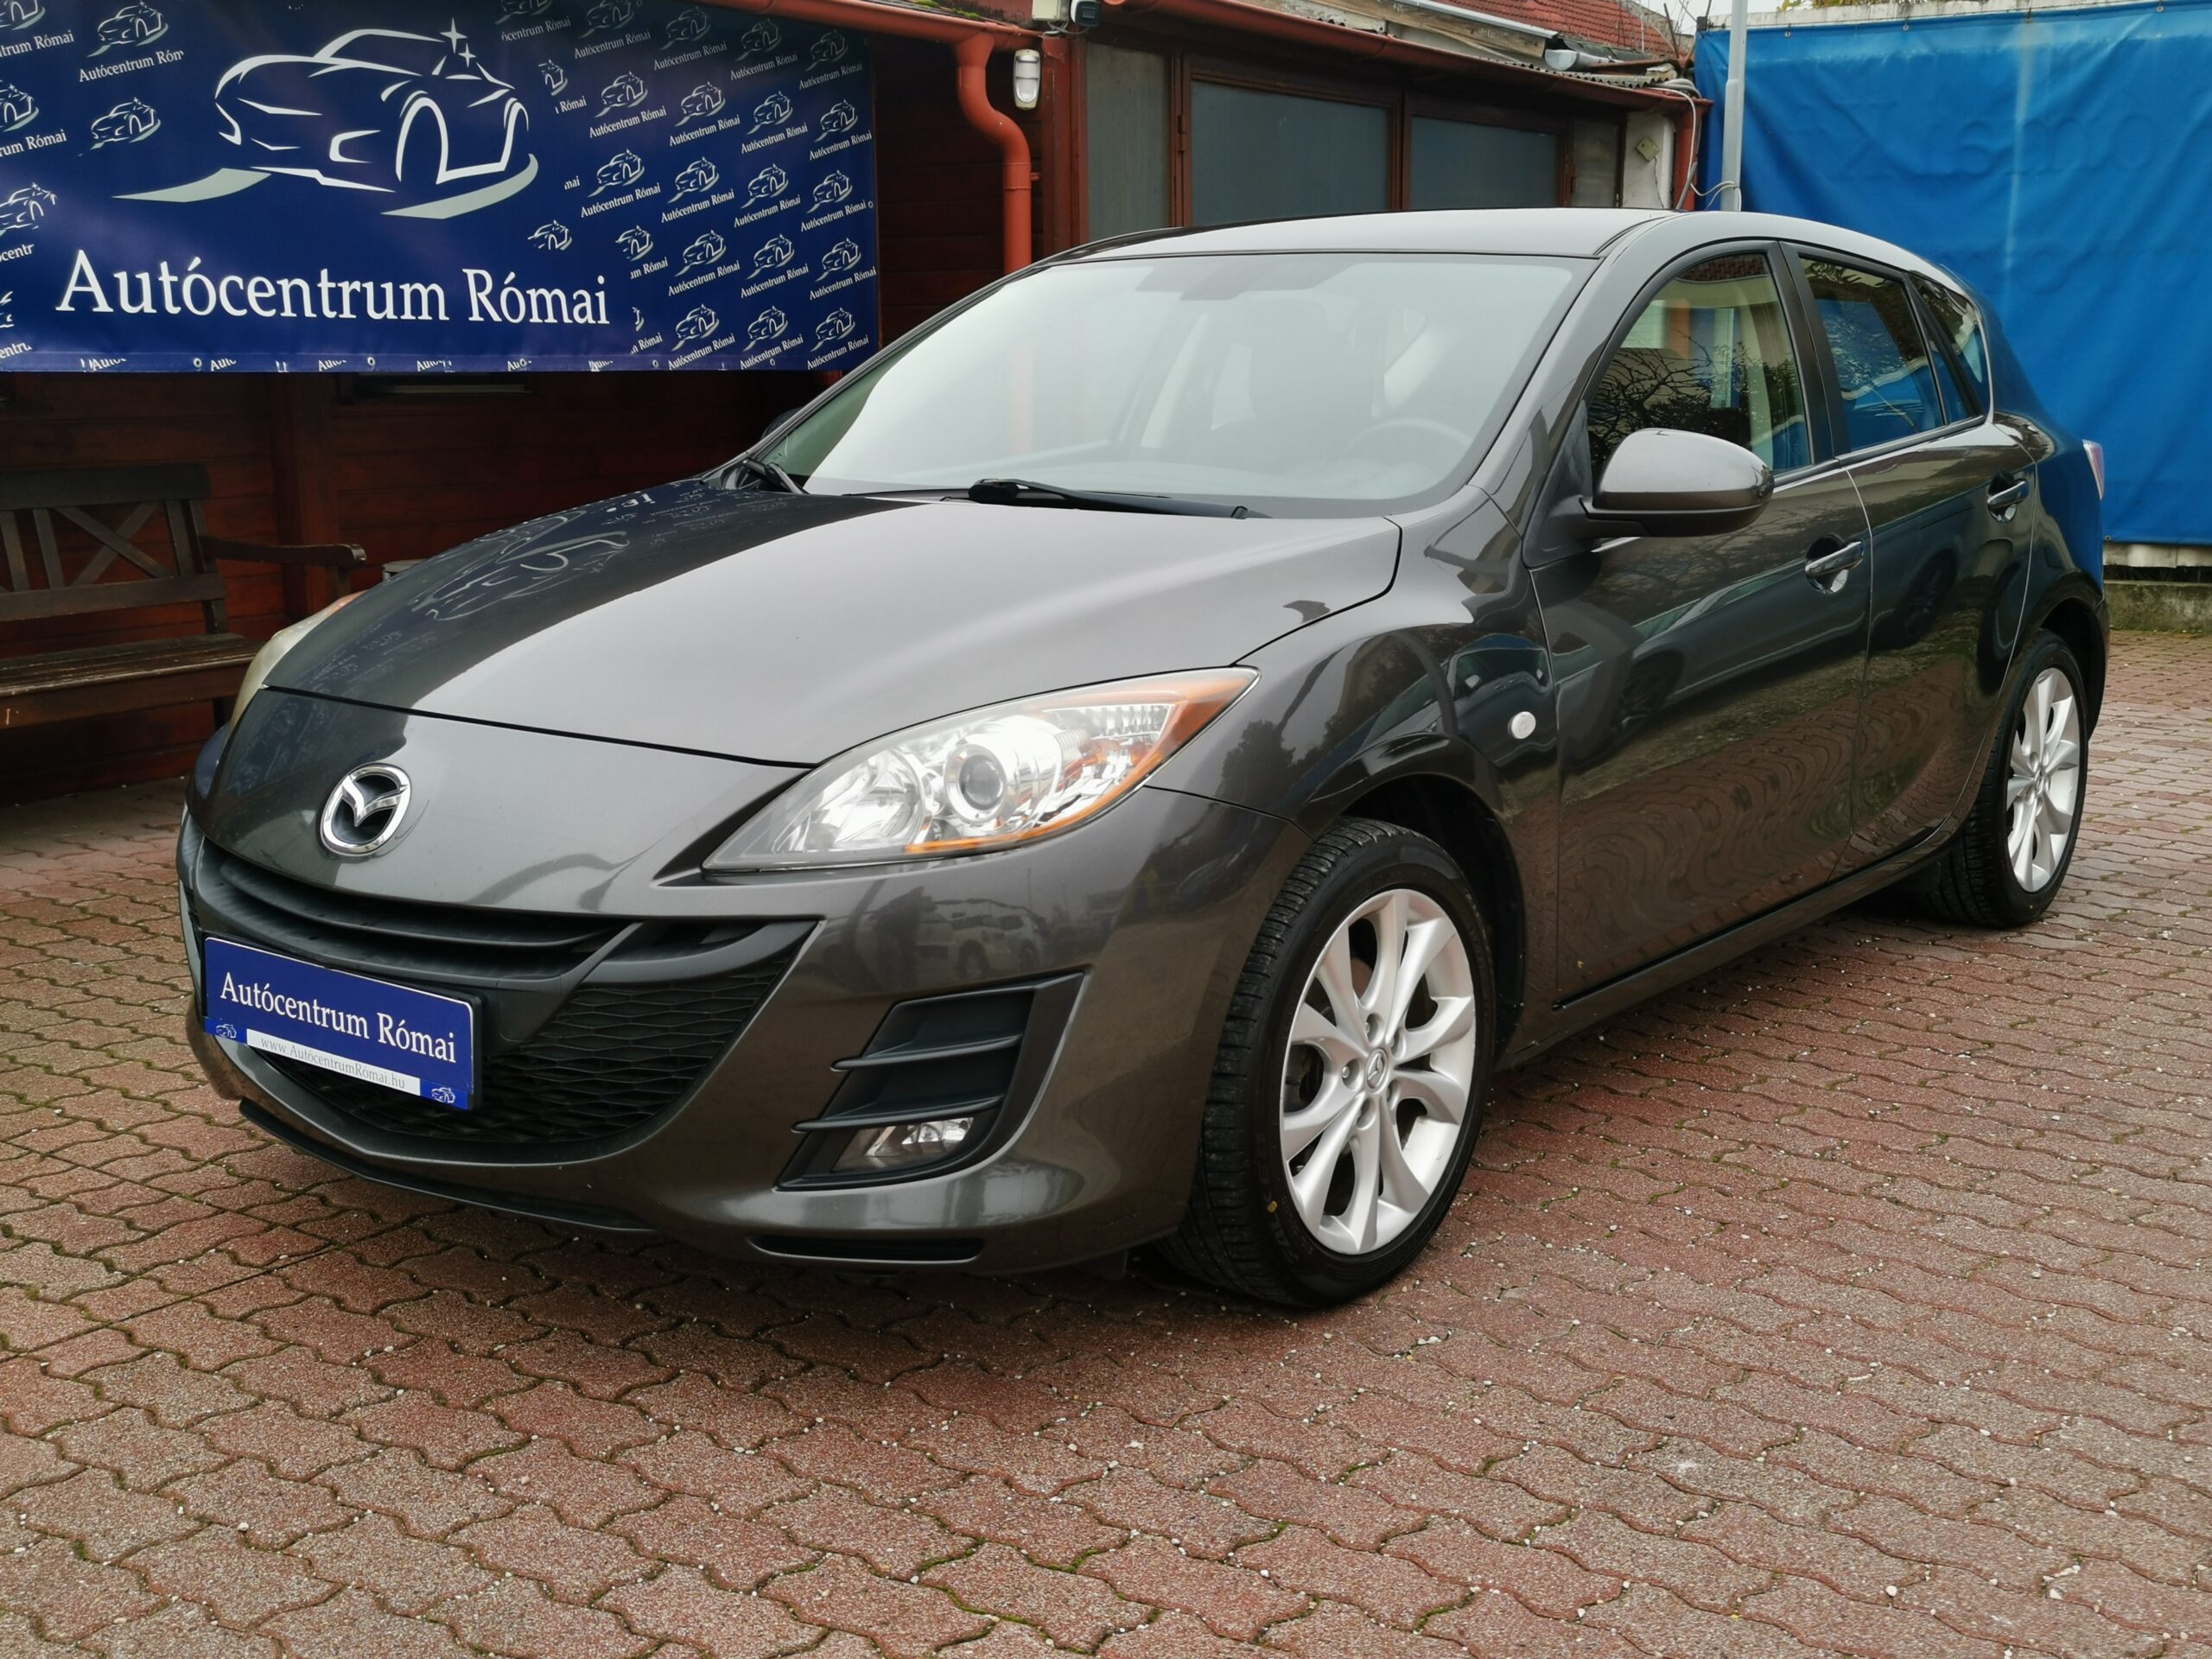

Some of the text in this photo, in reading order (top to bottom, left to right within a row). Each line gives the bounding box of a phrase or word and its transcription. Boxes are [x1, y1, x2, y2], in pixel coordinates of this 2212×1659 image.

[33, 29, 74, 49] Római
[545, 16, 571, 31] Római
[575, 29, 652, 59] Autócentrum Római
[653, 40, 728, 71] Autócentrum Római
[79, 57, 155, 82] Autócentrum
[730, 52, 798, 80] Autócentrum Római
[560, 95, 587, 112] Római
[589, 105, 667, 138] Autócentrum Római
[670, 114, 741, 146] Autócentrum Római
[25, 129, 67, 149] Római
[741, 123, 808, 154] Autócentrum Római
[809, 130, 873, 161] Autócentrum Római
[581, 182, 661, 218] Autócentrum Római
[661, 188, 734, 223] Autócentrum Római
[734, 194, 801, 227] Autócentrum Római
[801, 200, 866, 232] Autócentrum Római
[643, 257, 669, 274] Római
[669, 260, 741, 296] Autócentrum Római
[741, 263, 809, 298] Autócentrum Római
[55, 249, 610, 324] Autócentrum Római
[810, 266, 877, 300] Autócentrum Római
[639, 332, 663, 350] Római
[668, 333, 735, 371] Autócentrum Római
[740, 334, 804, 370] Autócentrum Római
[807, 334, 869, 371] Autócentrum Római
[220, 971, 457, 1064] Autócentrum Római
